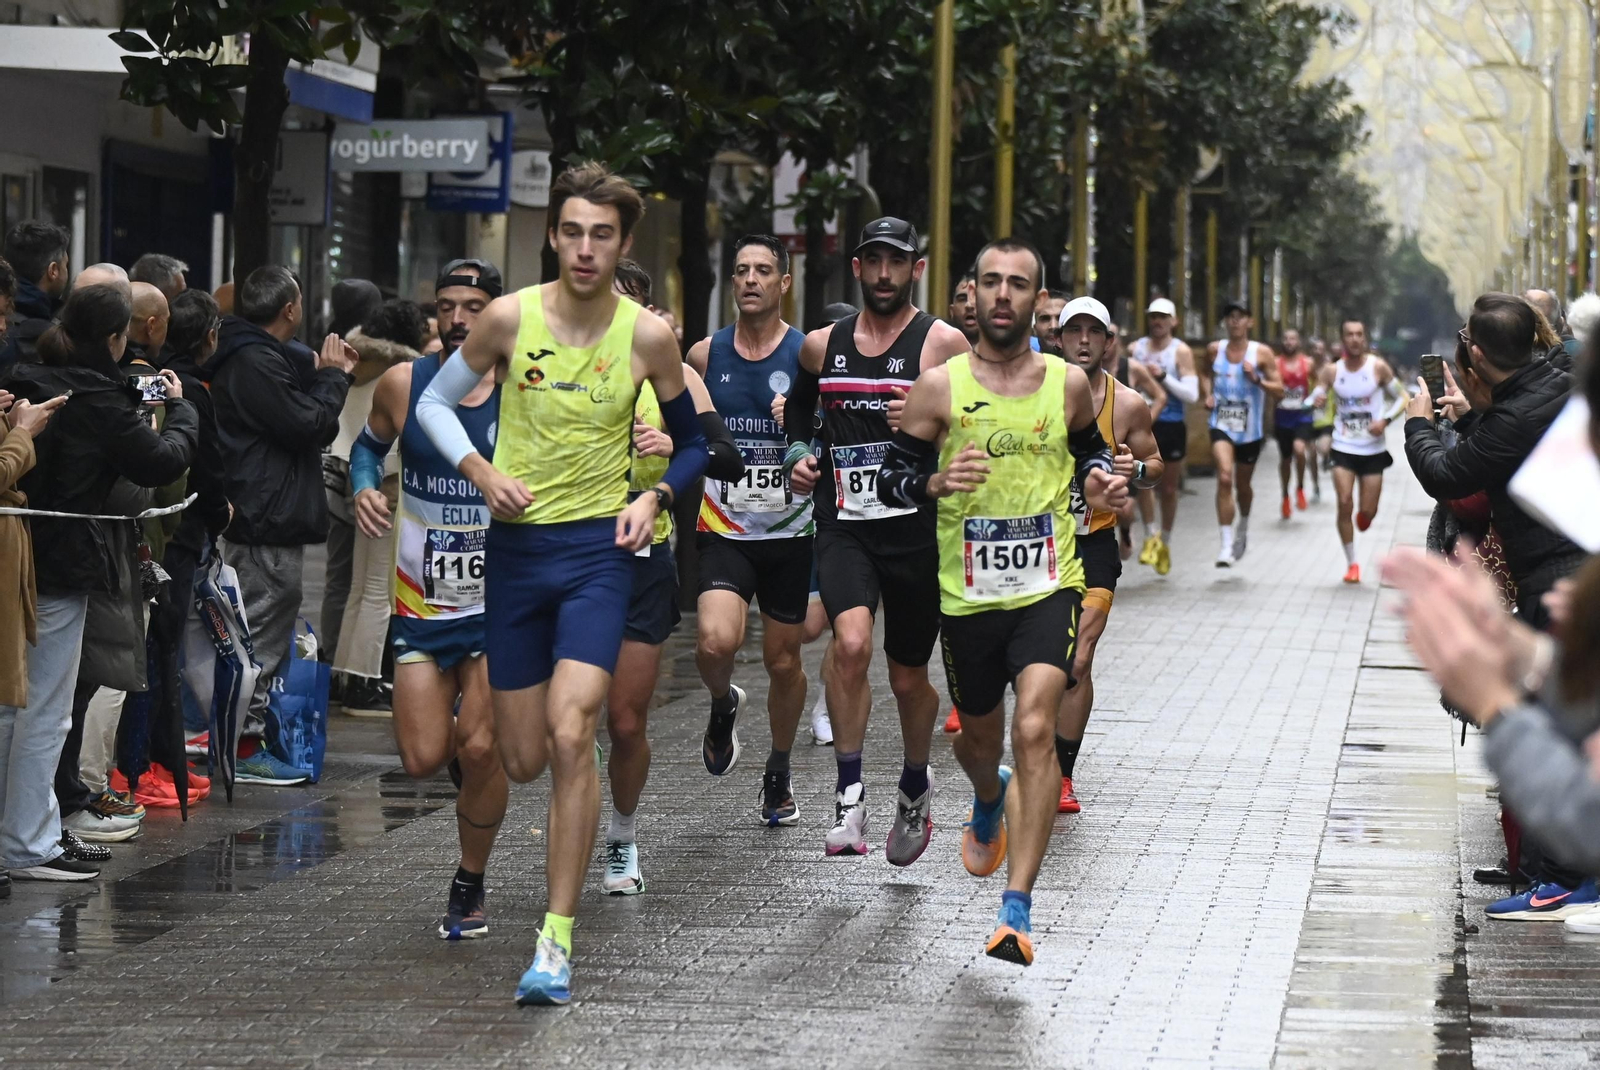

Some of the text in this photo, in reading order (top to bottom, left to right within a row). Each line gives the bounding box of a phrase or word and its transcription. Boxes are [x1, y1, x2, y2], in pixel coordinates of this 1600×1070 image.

[427, 475, 483, 498] MOSQU
[442, 504, 482, 526] ÉCIJA
[1006, 517, 1037, 527] MEDIA
[434, 540, 450, 551] 59
[463, 532, 487, 541] MEDI
[975, 541, 1045, 571] 1507
[434, 555, 486, 581] 116
